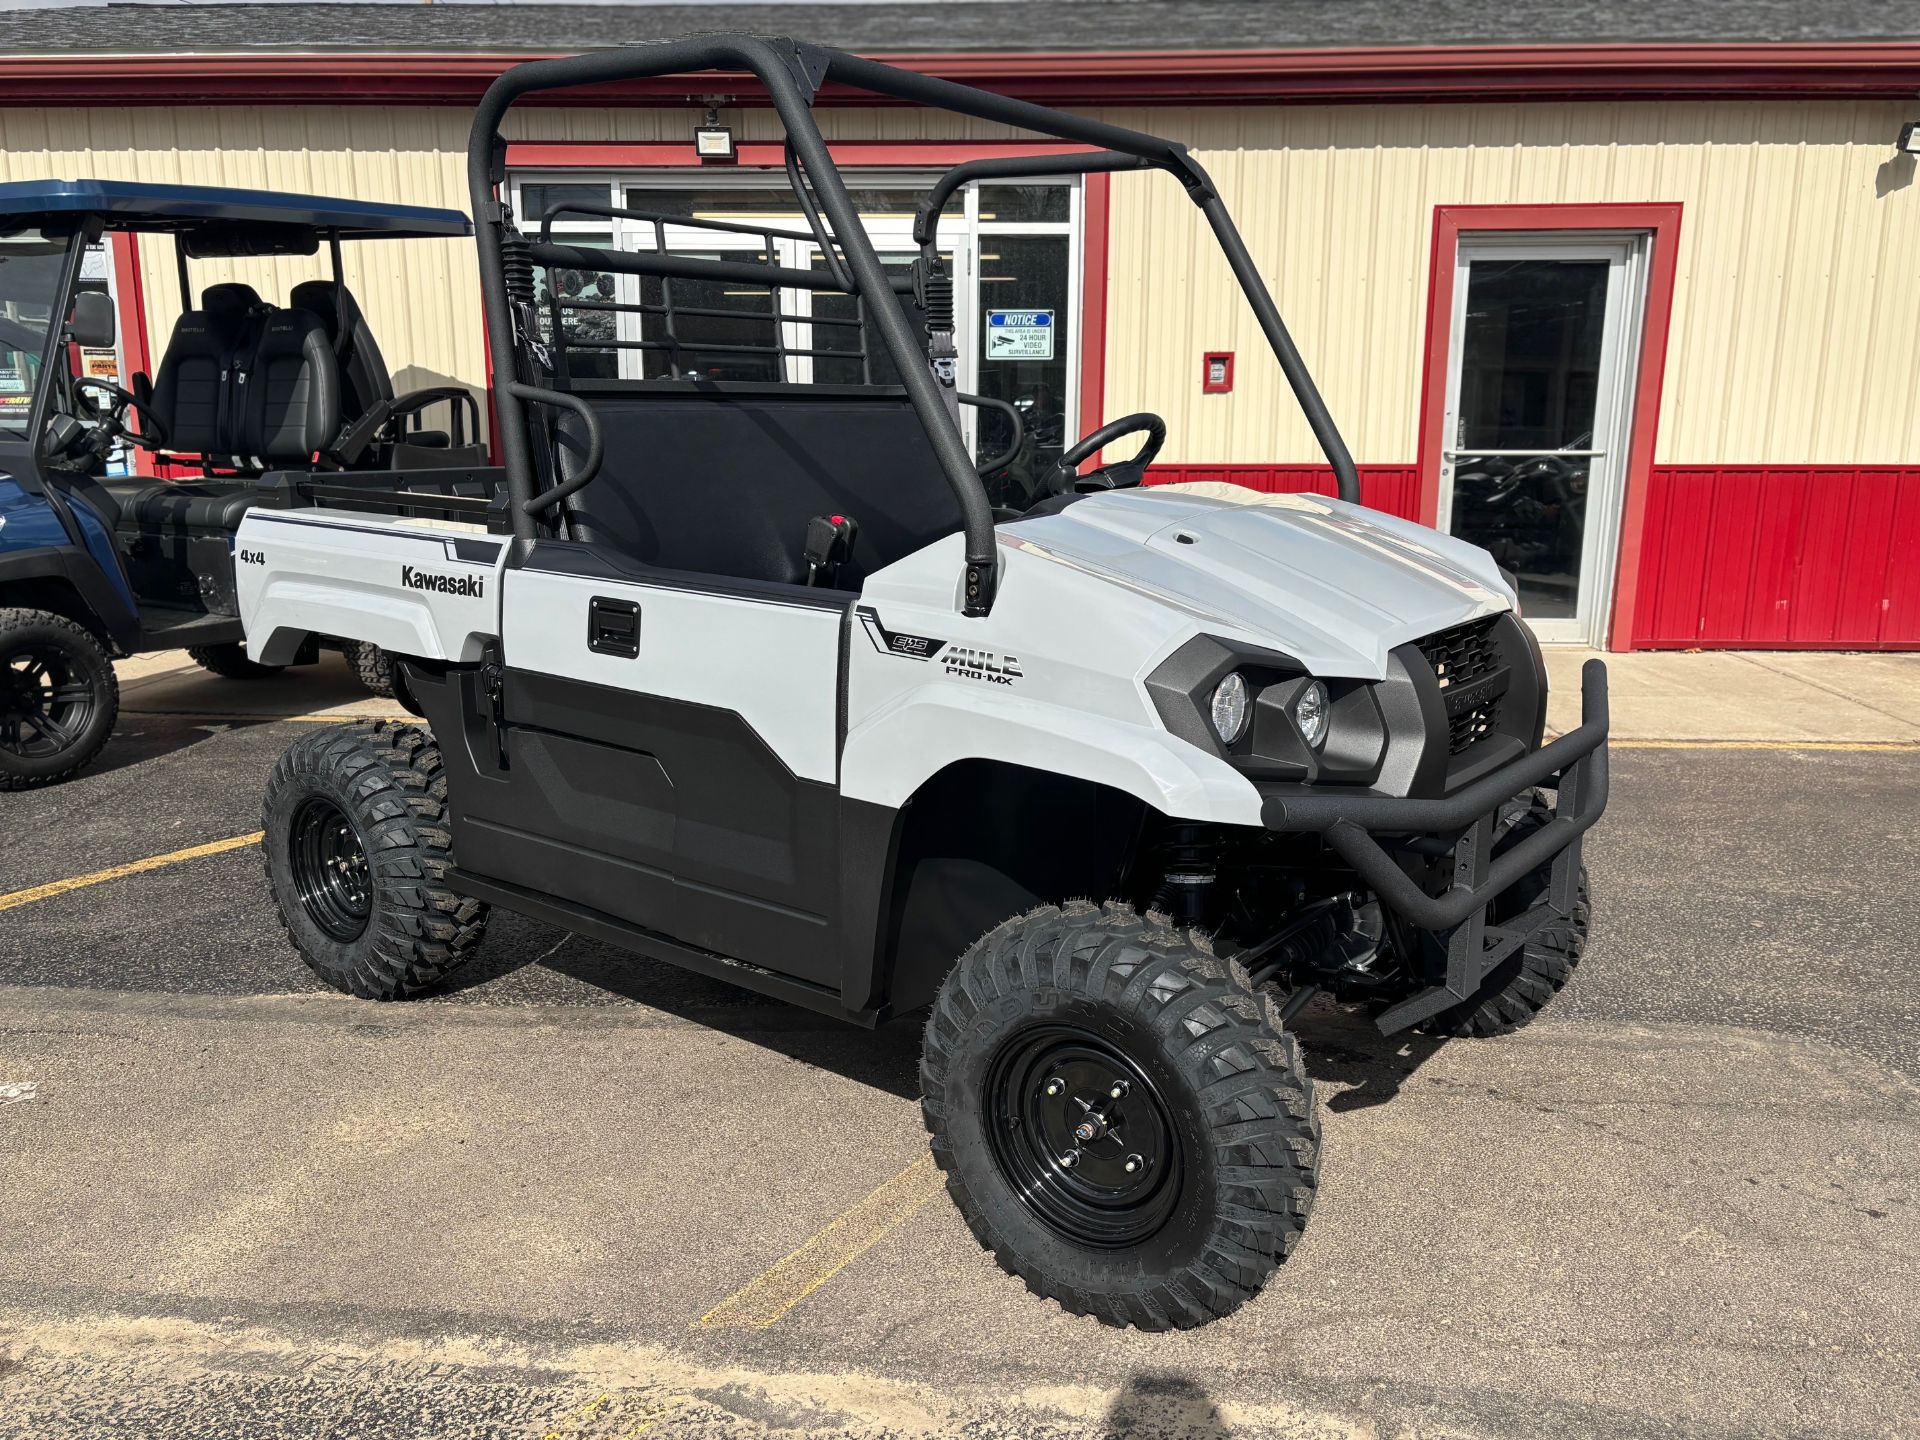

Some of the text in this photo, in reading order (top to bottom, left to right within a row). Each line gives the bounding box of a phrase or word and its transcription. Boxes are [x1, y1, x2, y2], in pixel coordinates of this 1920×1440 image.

[538, 307, 574, 315] ME US
[539, 317, 552, 325] OU
[1003, 314, 1038, 325] NOTICE
[240, 549, 265, 565] 4x4
[402, 565, 484, 598] Kawasaki
[893, 635, 928, 650] EPS
[940, 646, 1023, 678] MULE
[945, 665, 1013, 686] PRO-MX
